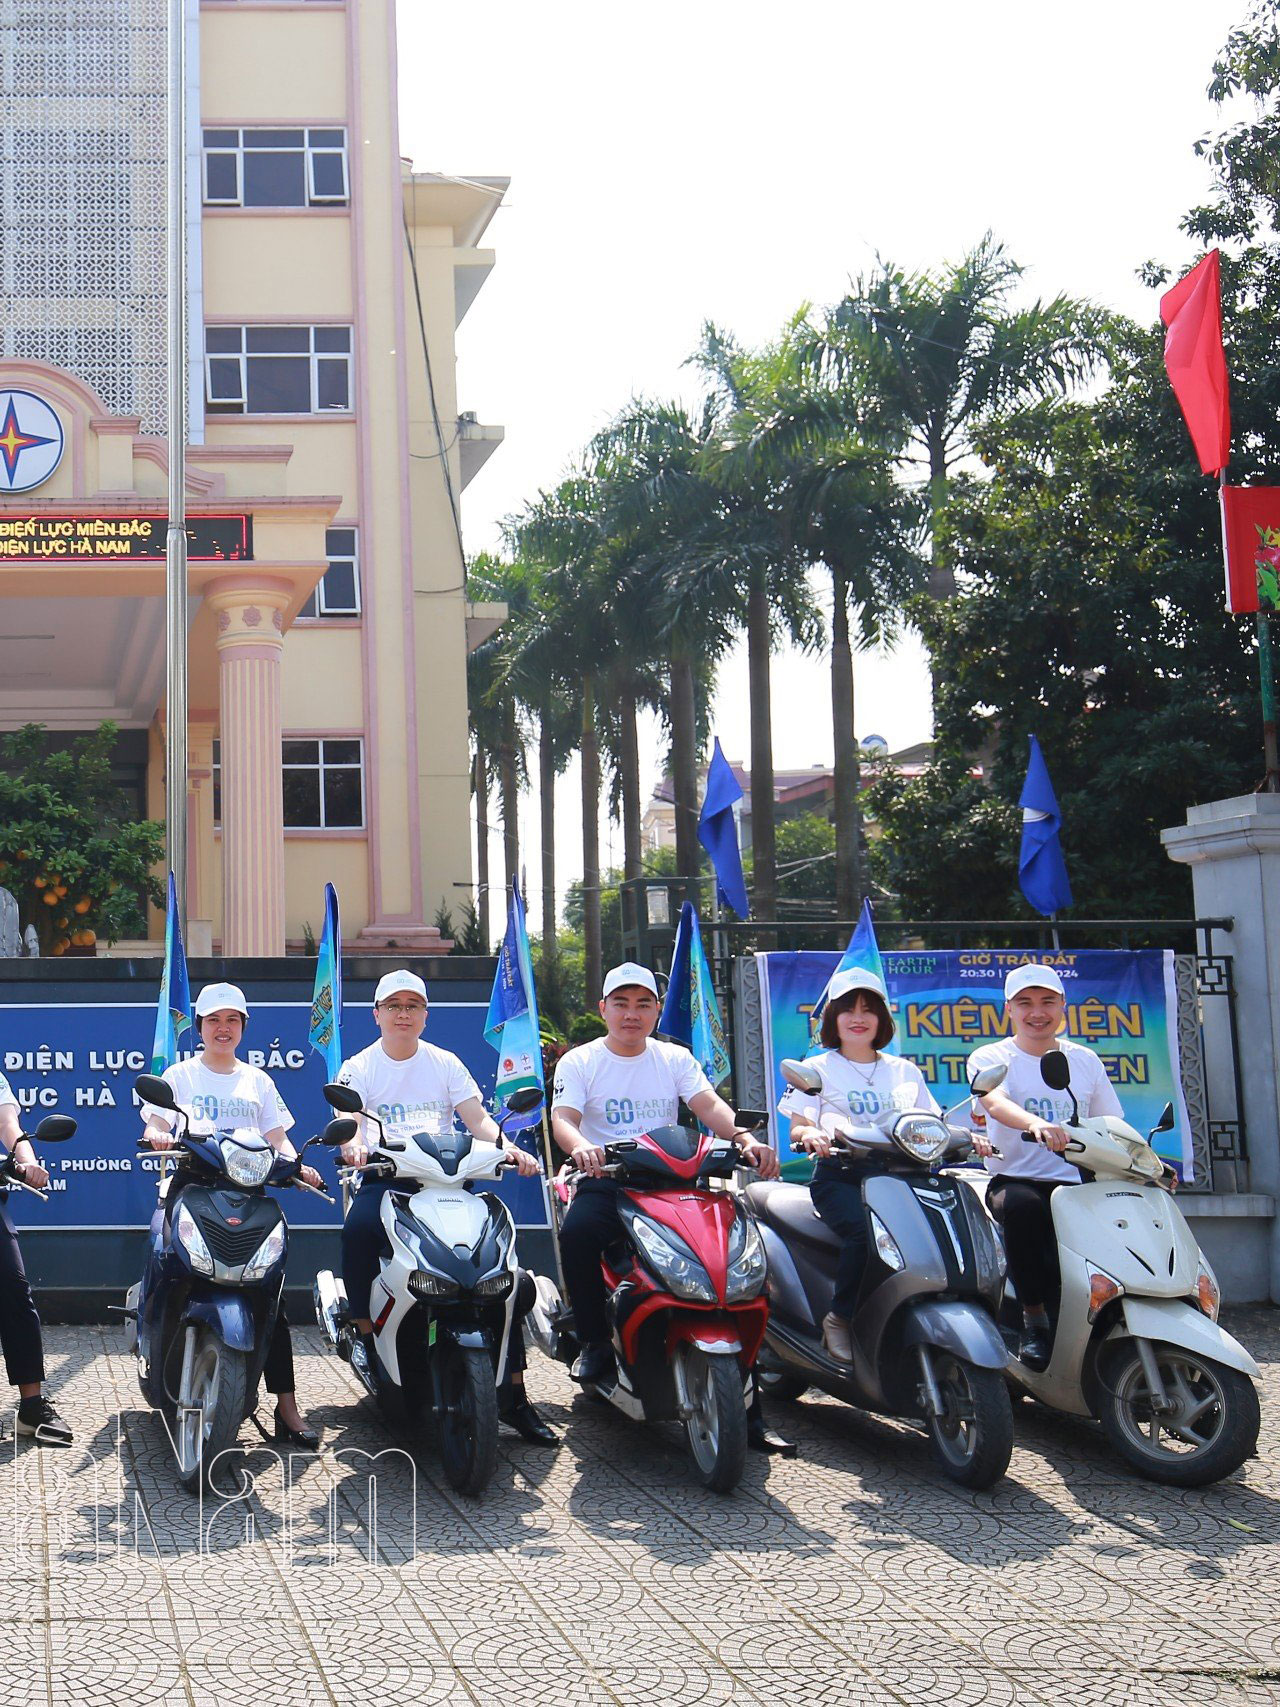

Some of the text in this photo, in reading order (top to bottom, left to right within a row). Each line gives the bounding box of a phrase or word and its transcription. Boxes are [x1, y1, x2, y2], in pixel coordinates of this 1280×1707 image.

[33, 540, 67, 556] LỰC
[70, 537, 93, 554] HÀ
[95, 540, 131, 554] NAM
[888, 957, 937, 967] EARTH
[959, 953, 992, 965] GIỜ
[996, 953, 1038, 965] TRÁI
[887, 966, 934, 975] HOUR
[959, 969, 995, 978] 20:30
[906, 996, 1018, 1042] KIỆM
[4, 1044, 74, 1076] ĐIỆN
[89, 1050, 145, 1076] LỰC
[248, 1037, 305, 1070] BẮC
[18, 1087, 59, 1113] ỰC
[75, 1081, 113, 1107] HÀ
[847, 1090, 880, 1115] 60
[191, 1094, 219, 1121] 60
[605, 1098, 676, 1125] 60 EARTH
[636, 1108, 673, 1119] HOUR
[61, 1156, 133, 1172] PHƯỜNG
